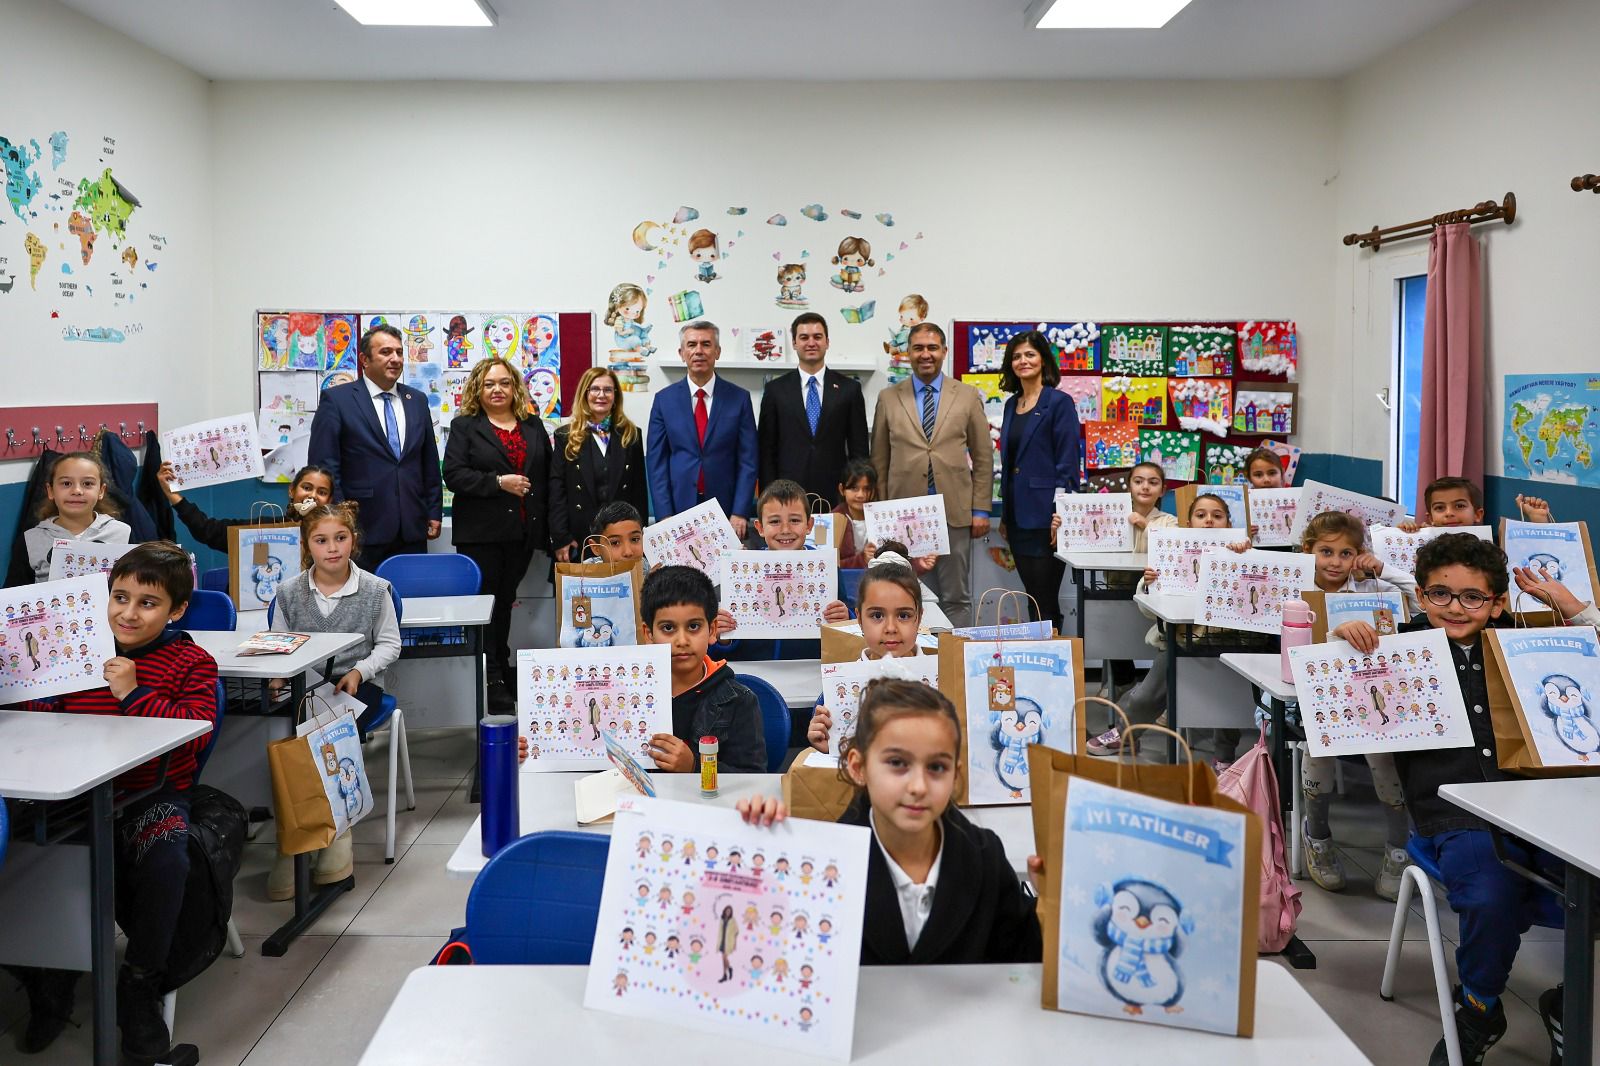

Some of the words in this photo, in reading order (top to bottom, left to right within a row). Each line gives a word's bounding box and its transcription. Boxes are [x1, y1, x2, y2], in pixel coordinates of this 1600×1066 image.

[1529, 638, 1583, 650] TATİLLER
[1087, 806, 1112, 825] İYİ
[1117, 811, 1211, 849] TATİLLER
